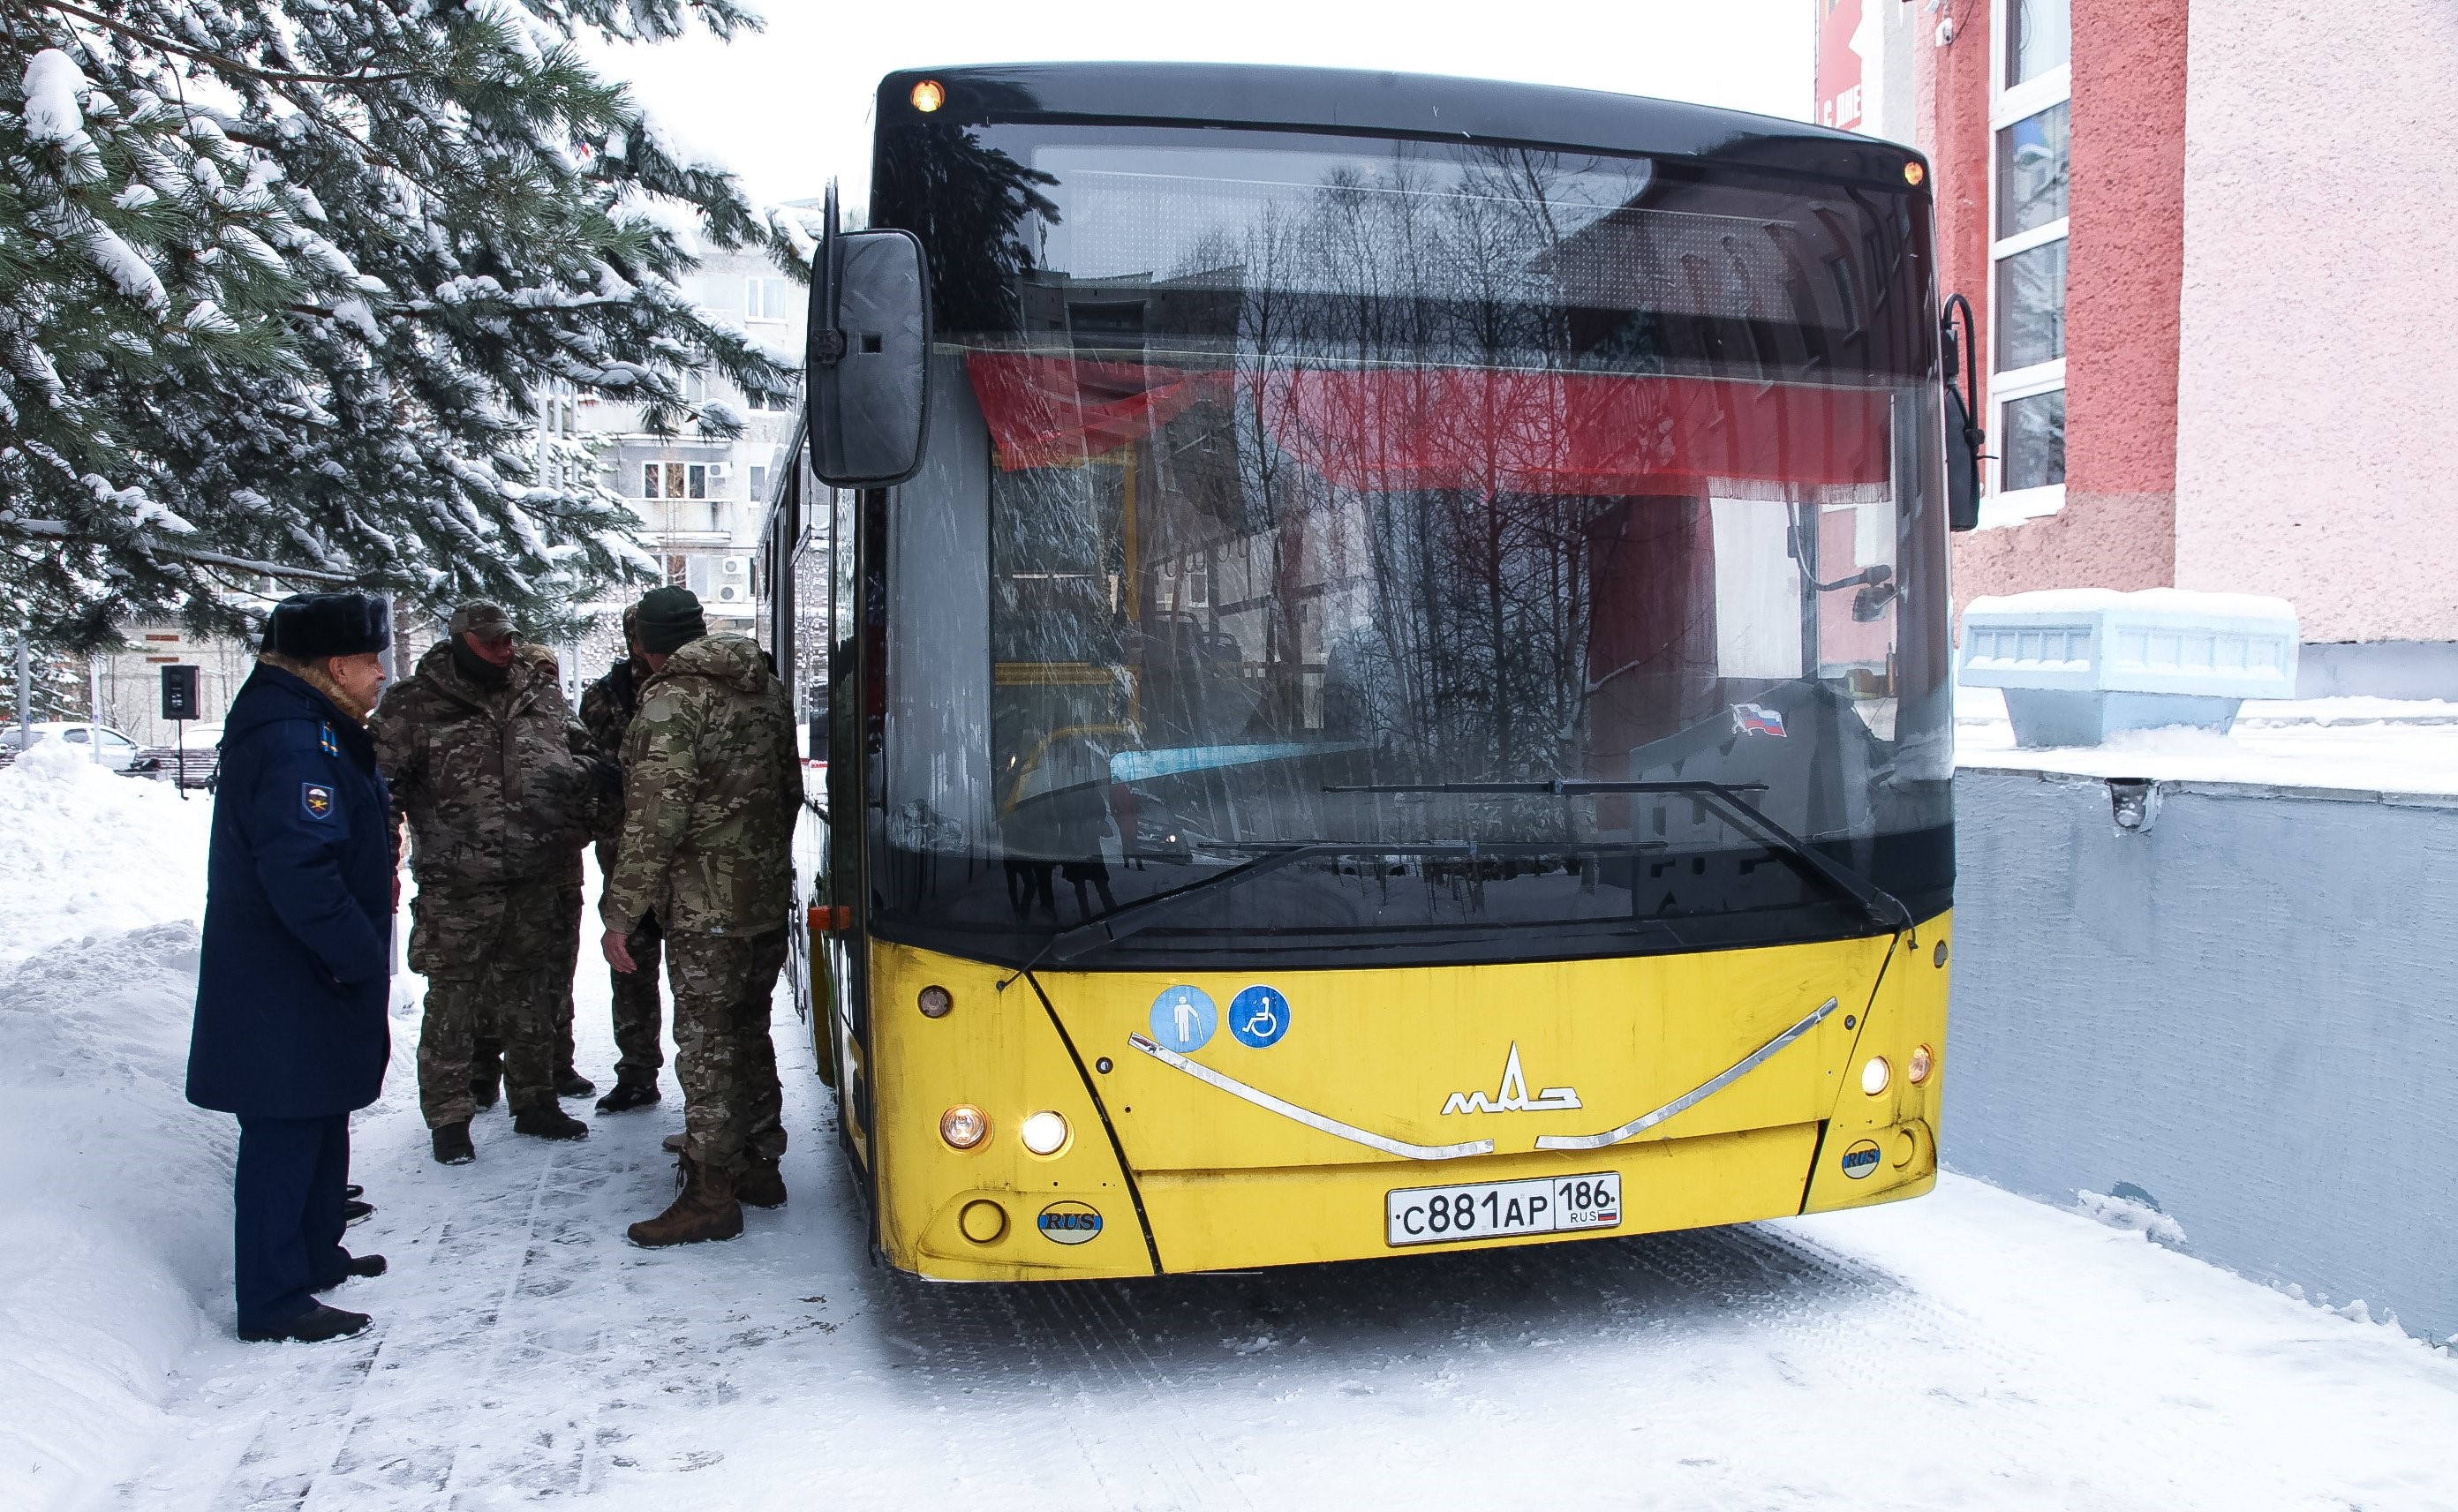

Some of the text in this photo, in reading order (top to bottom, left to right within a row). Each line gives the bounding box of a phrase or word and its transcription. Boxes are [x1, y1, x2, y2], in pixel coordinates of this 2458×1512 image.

[1847, 1148, 1877, 1169] RUS
[1558, 1179, 1610, 1211] 186
[1044, 1213, 1096, 1230] RUS
[1570, 1211, 1597, 1223] RUS
